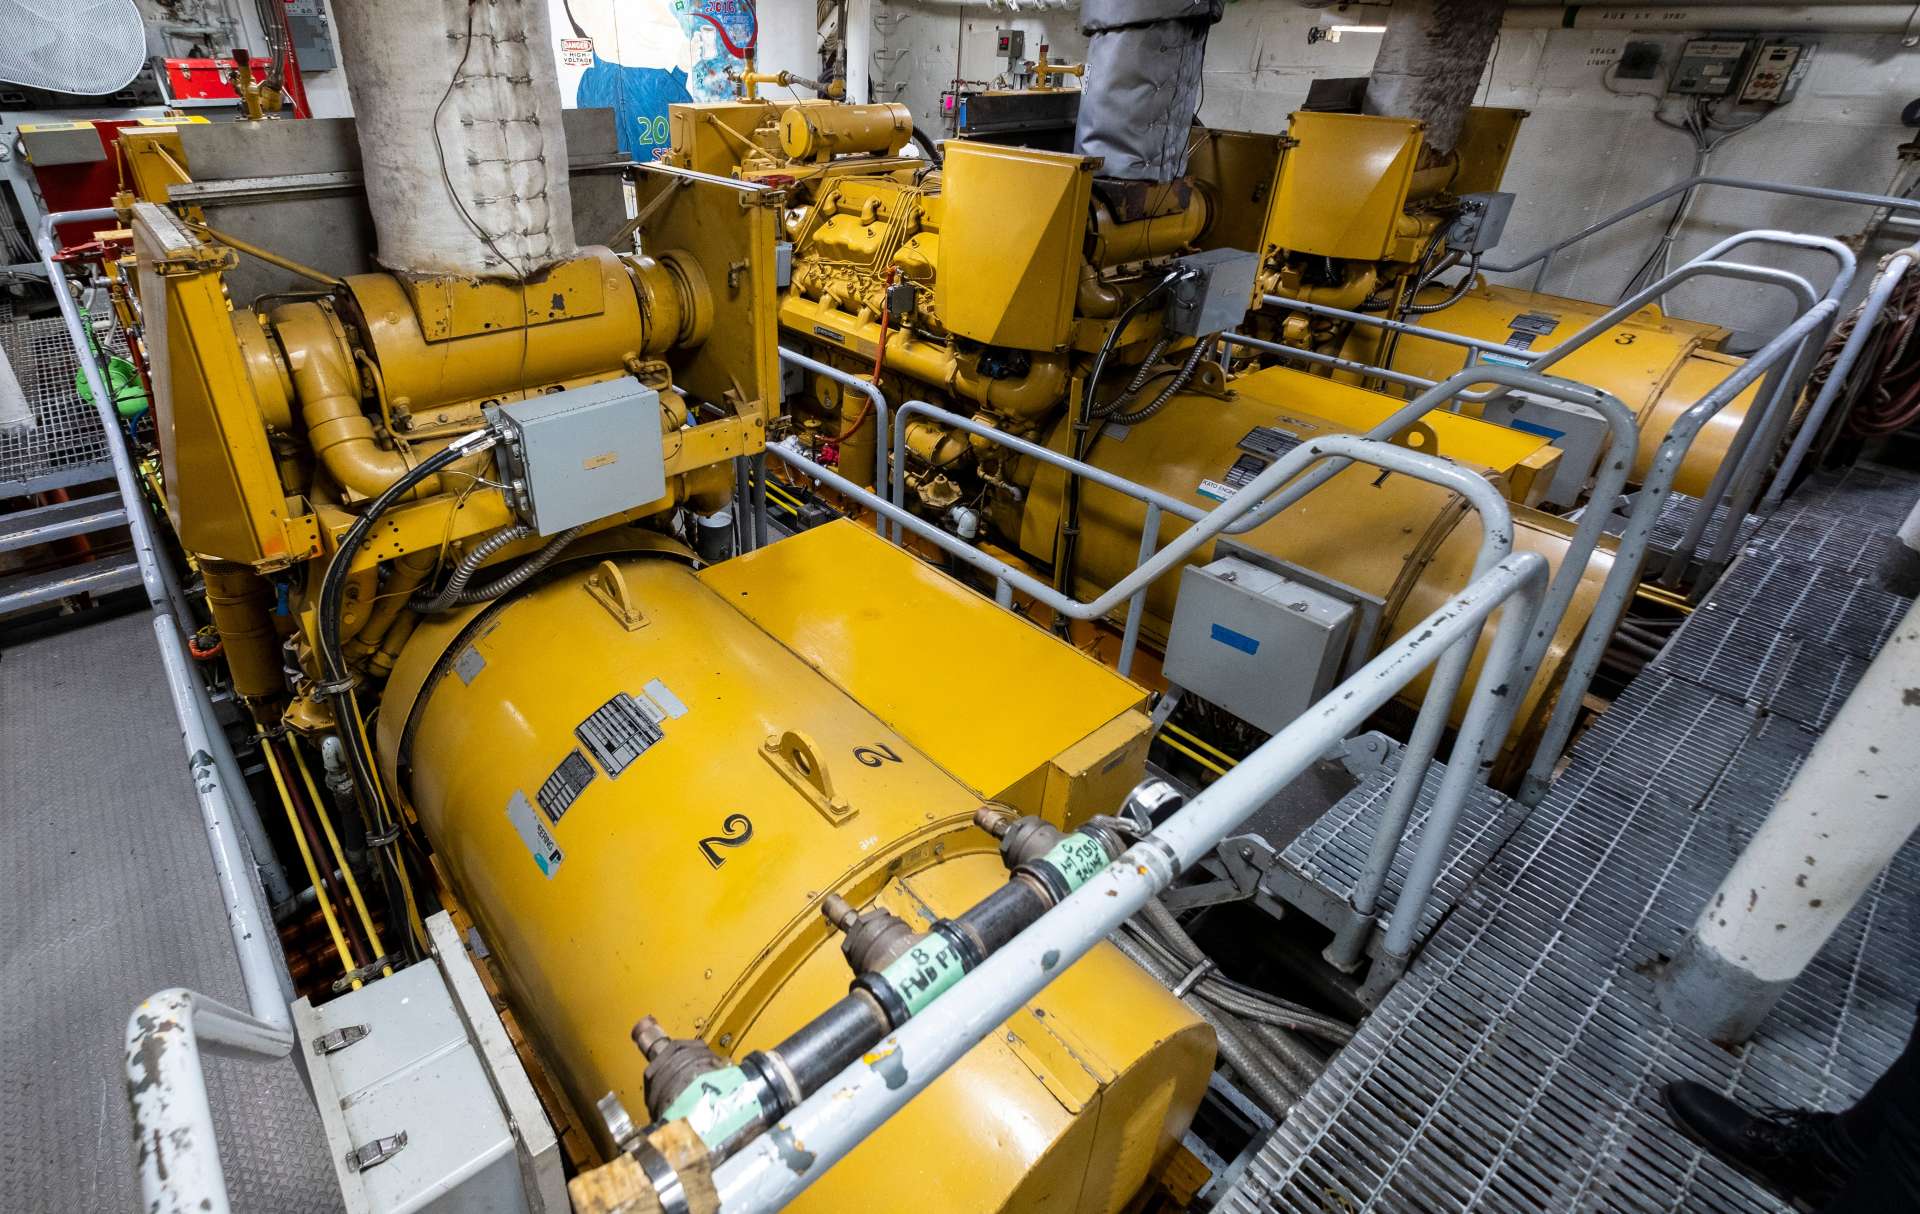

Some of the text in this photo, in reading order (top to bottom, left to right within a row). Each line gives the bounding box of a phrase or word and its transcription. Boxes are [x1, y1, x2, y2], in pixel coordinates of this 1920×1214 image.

[1615, 333, 1637, 345] 3
[853, 742, 903, 768] 2
[698, 813, 753, 870] 2
[911, 948, 930, 965] B
[900, 966, 938, 1000] FWD
